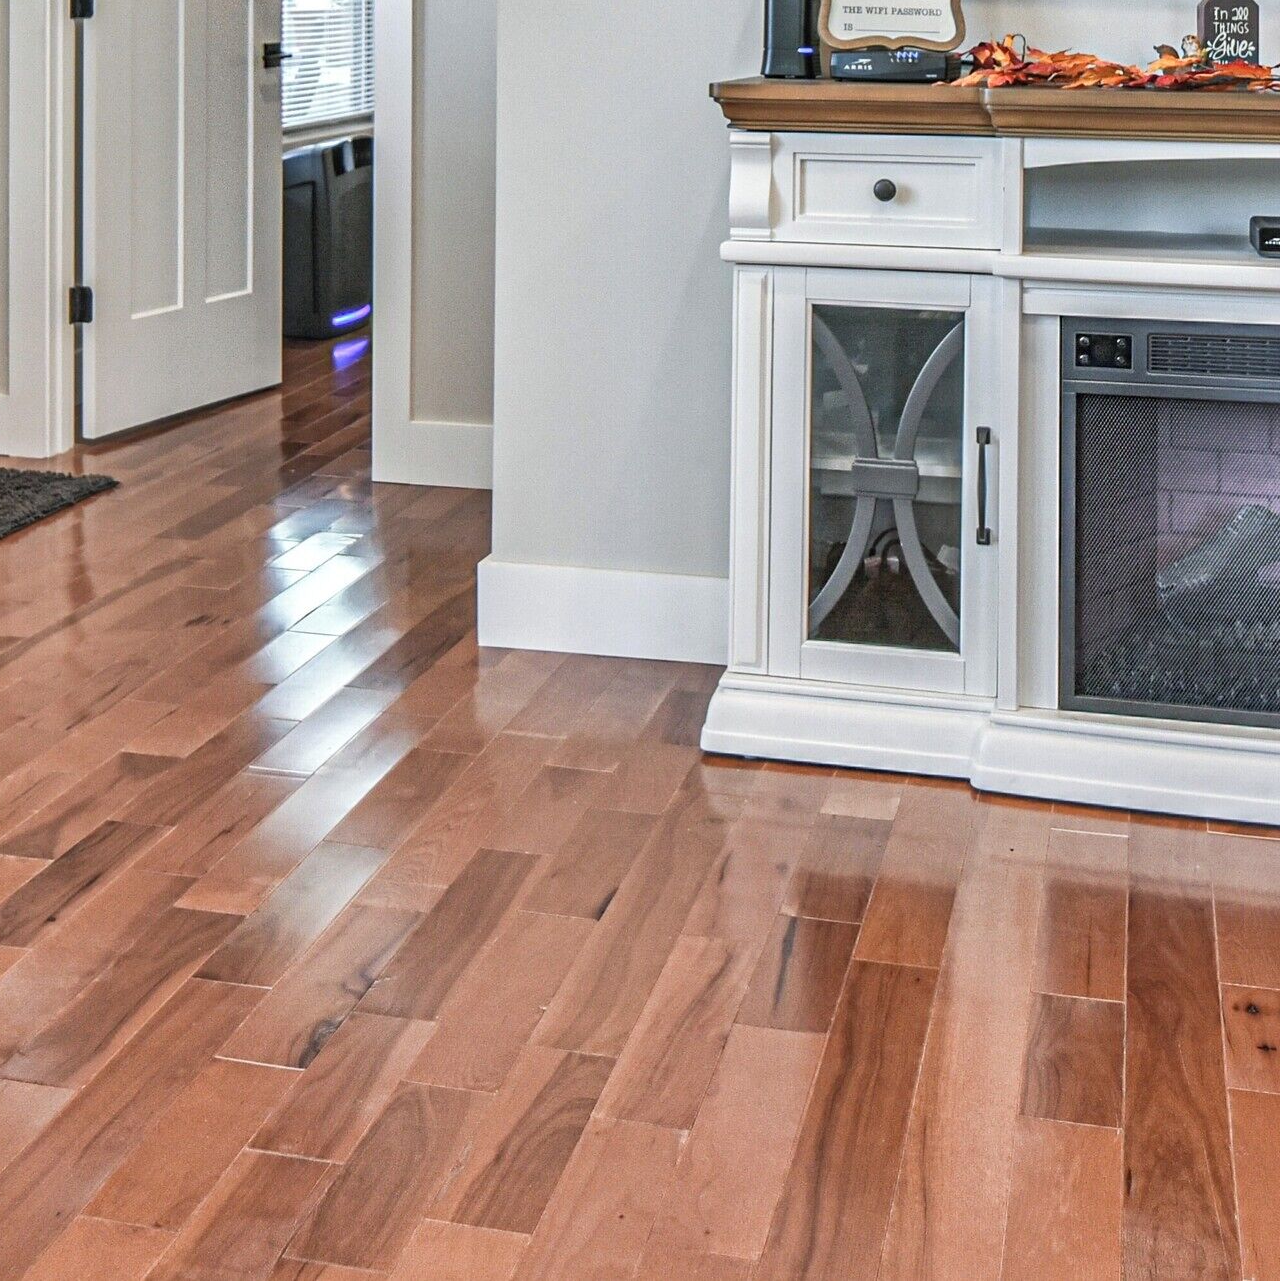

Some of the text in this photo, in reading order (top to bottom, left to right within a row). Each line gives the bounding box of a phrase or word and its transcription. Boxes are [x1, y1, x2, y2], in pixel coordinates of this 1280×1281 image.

[842, 5, 943, 17] THE WIFI PASSWORD
[1213, 6, 1229, 20] In
[843, 22, 854, 32] IS
[1212, 21, 1250, 35] THINGS
[1212, 31, 1249, 60] Give
